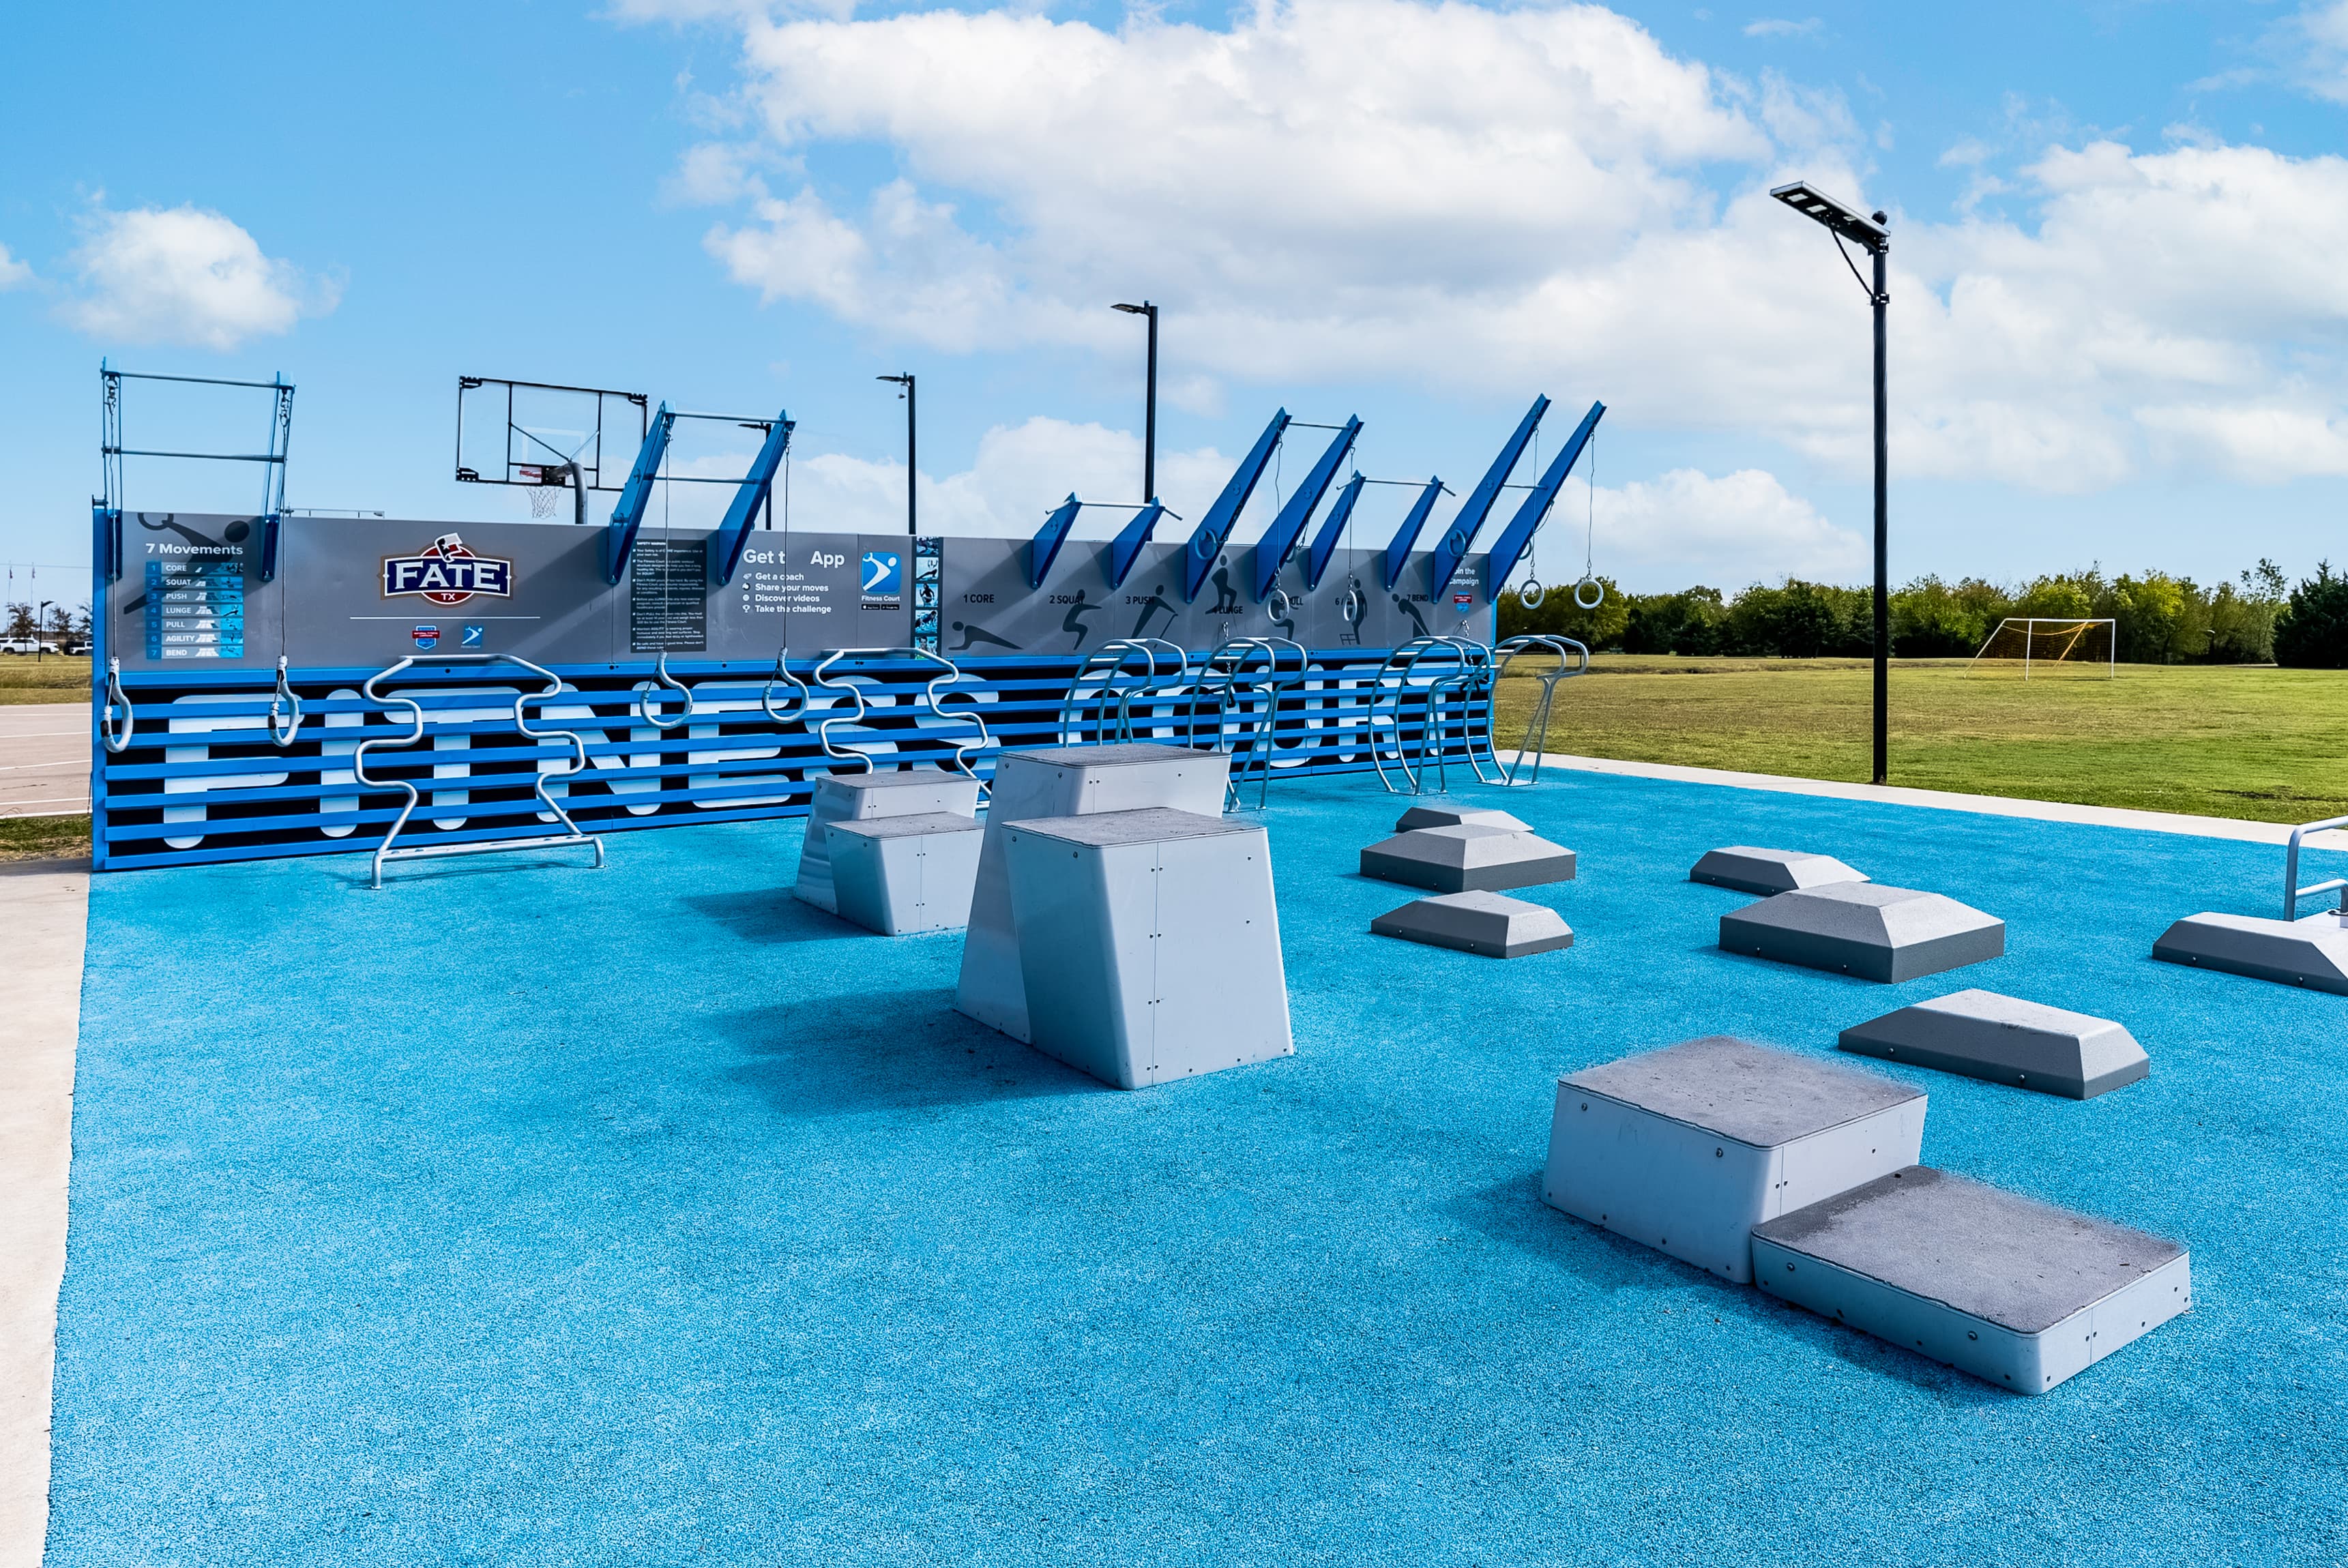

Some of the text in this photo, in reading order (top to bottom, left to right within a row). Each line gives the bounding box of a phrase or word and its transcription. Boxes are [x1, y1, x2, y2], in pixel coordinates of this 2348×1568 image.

[145, 543, 244, 554] 7 Movements
[743, 548, 774, 564] Get
[810, 550, 845, 568] App
[1465, 567, 1476, 575] the
[394, 561, 501, 591] FATE
[755, 572, 771, 580] Get
[755, 583, 780, 591] Share
[441, 593, 456, 601] TX
[755, 594, 821, 602] Discover videos
[963, 594, 995, 604] 1 CORE
[1049, 595, 1085, 604] 2 SQUAT
[1126, 595, 1155, 605] 3 PUSH
[1335, 597, 1340, 606] 6
[792, 605, 832, 614] challenge
[1219, 606, 1244, 615] LUNGE
